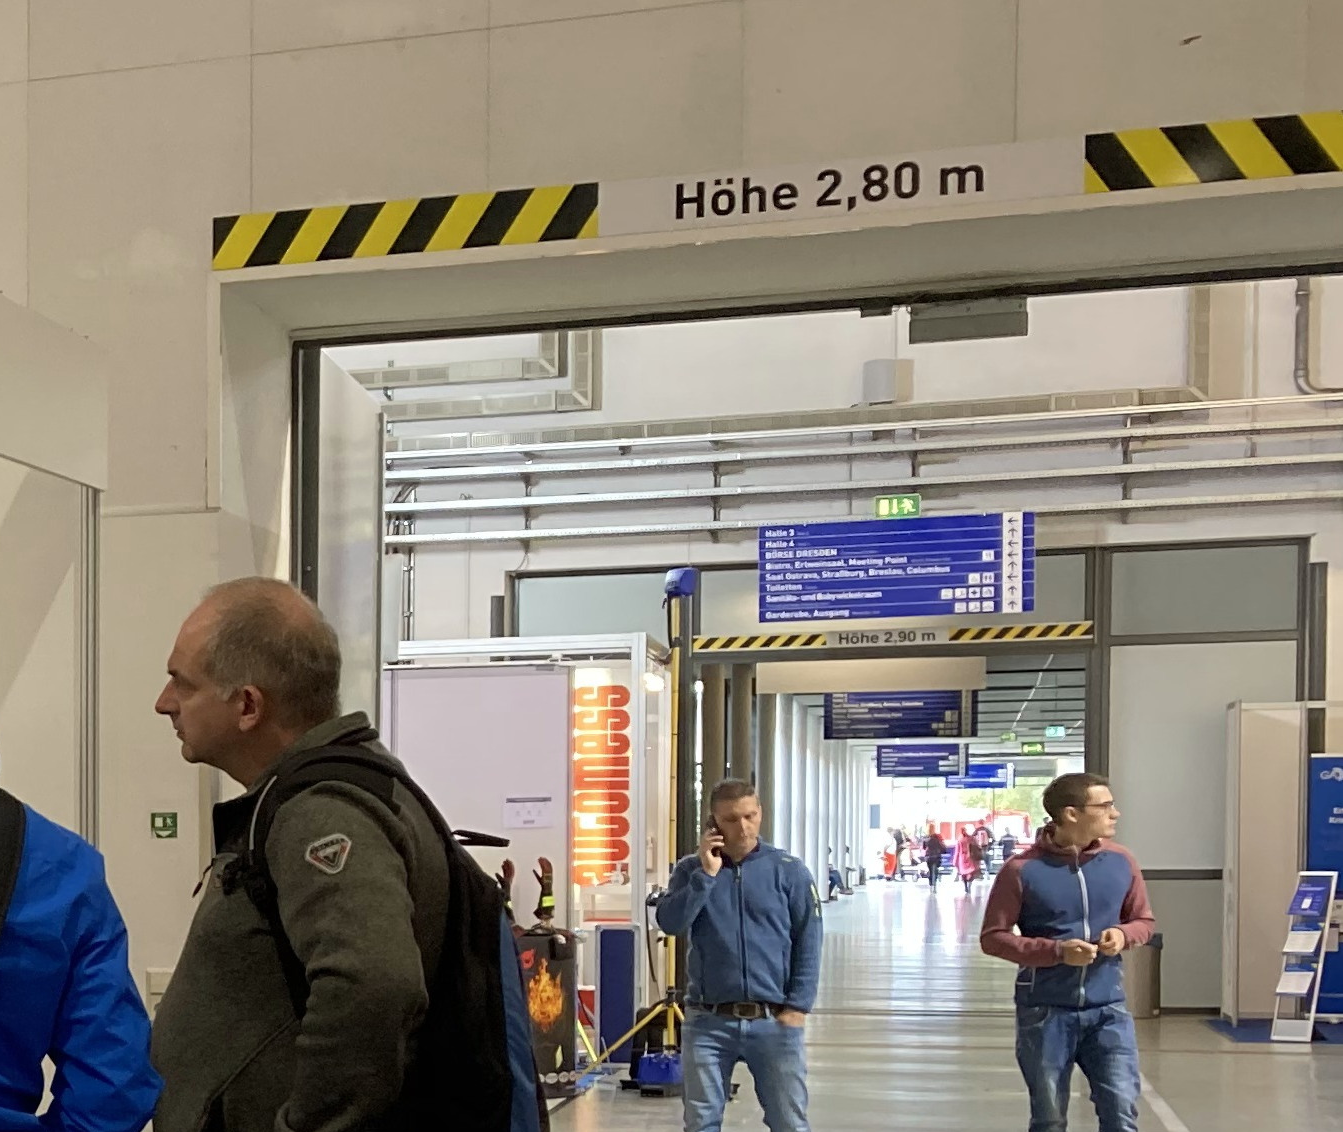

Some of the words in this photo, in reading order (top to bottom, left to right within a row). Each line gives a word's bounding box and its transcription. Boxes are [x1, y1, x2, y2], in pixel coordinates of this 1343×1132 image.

[675, 177, 798, 219] Höhe
[816, 161, 920, 211] 2,80
[939, 163, 984, 195] m
[838, 631, 879, 645] Höhe
[921, 631, 936, 642] m
